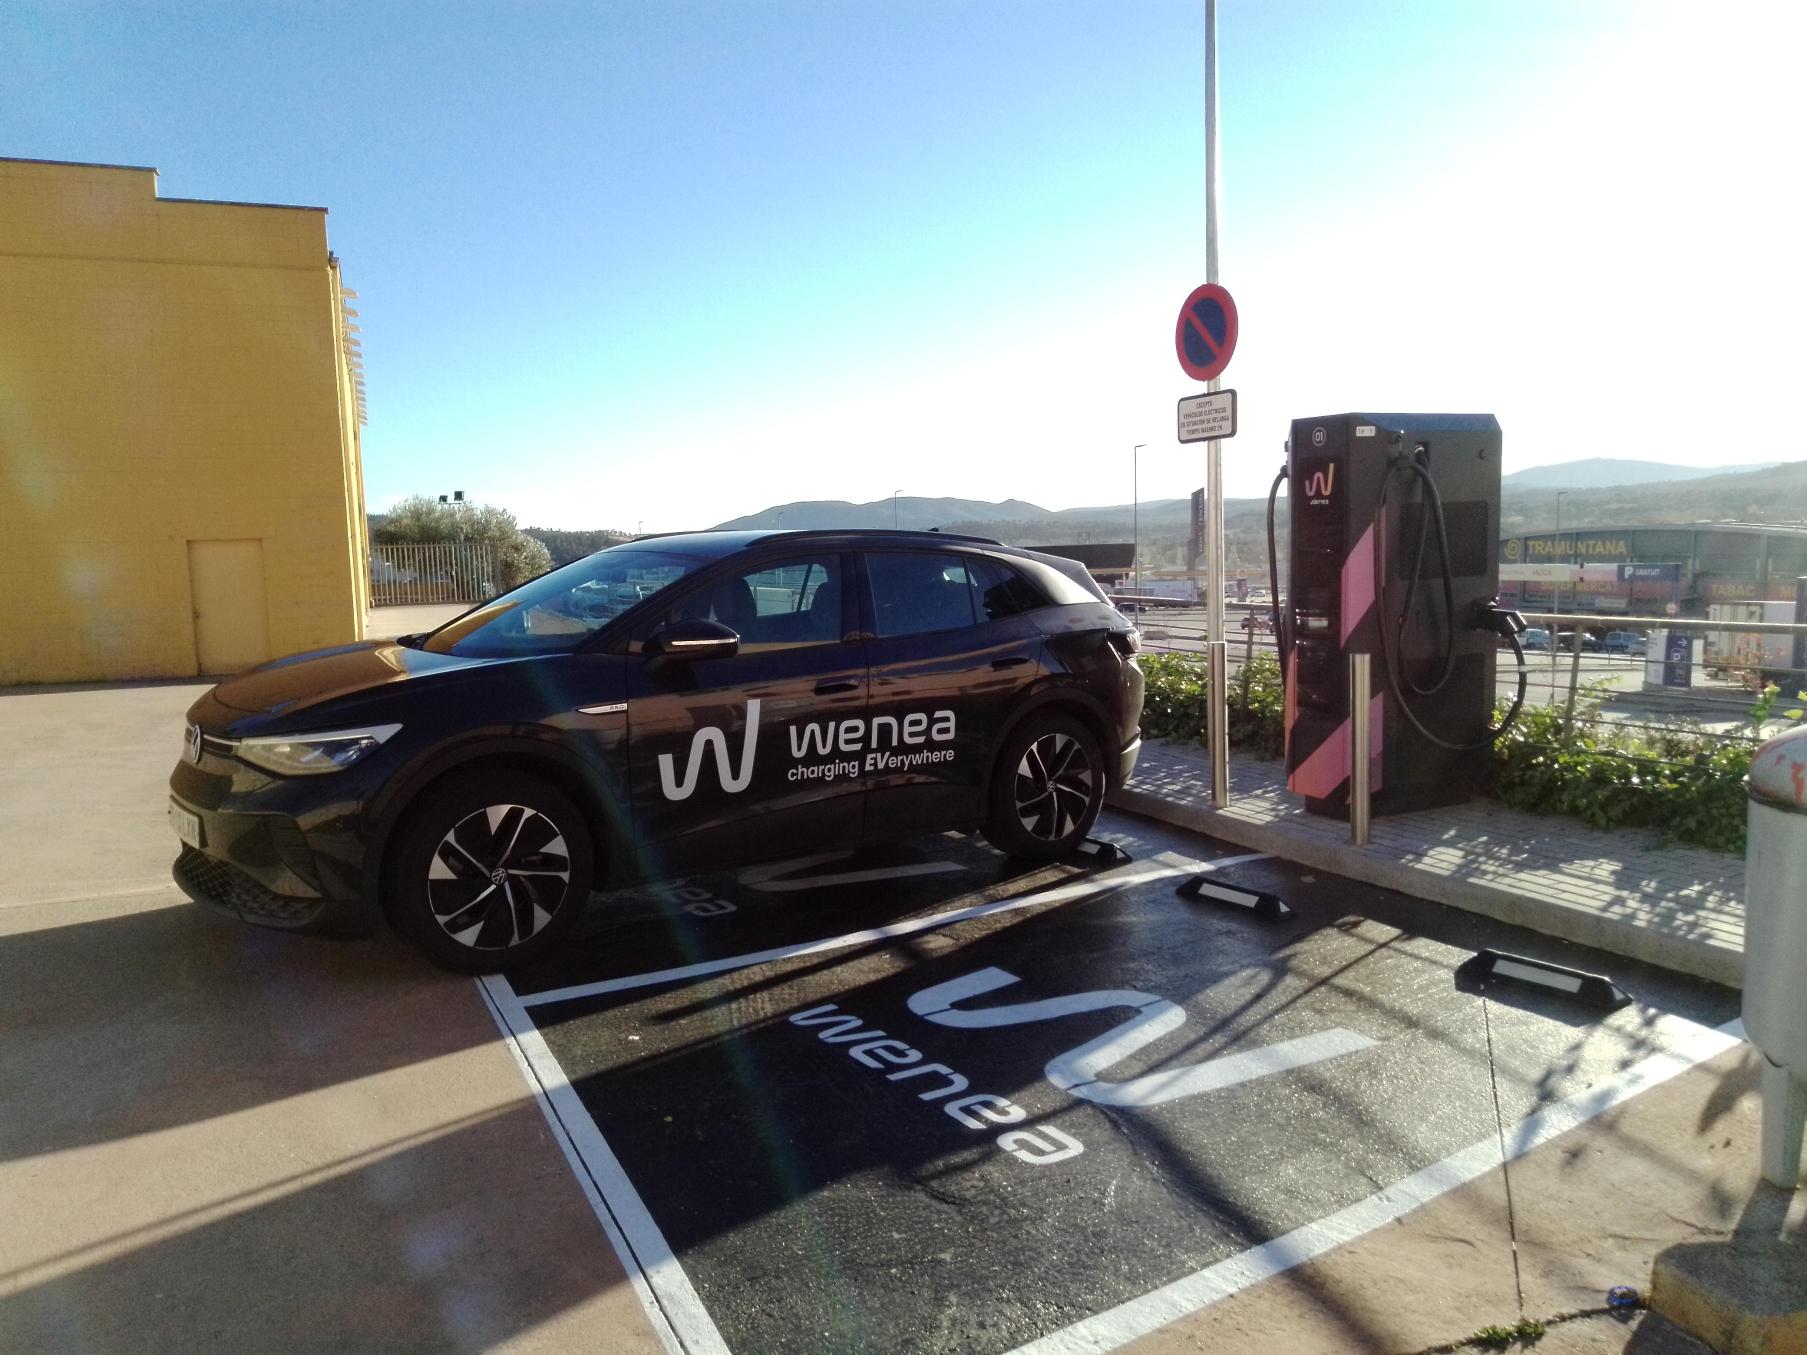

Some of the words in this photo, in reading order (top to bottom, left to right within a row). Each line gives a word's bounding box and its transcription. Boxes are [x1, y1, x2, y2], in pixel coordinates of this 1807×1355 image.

[1315, 431, 1324, 442] 01
[1526, 540, 1628, 556] TRAMUNTANA
[1624, 566, 1634, 579] P
[789, 709, 956, 758] wenea
[787, 759, 859, 781] charging
[864, 749, 955, 771] EVerywhere
[788, 1004, 1085, 1165] wenea
